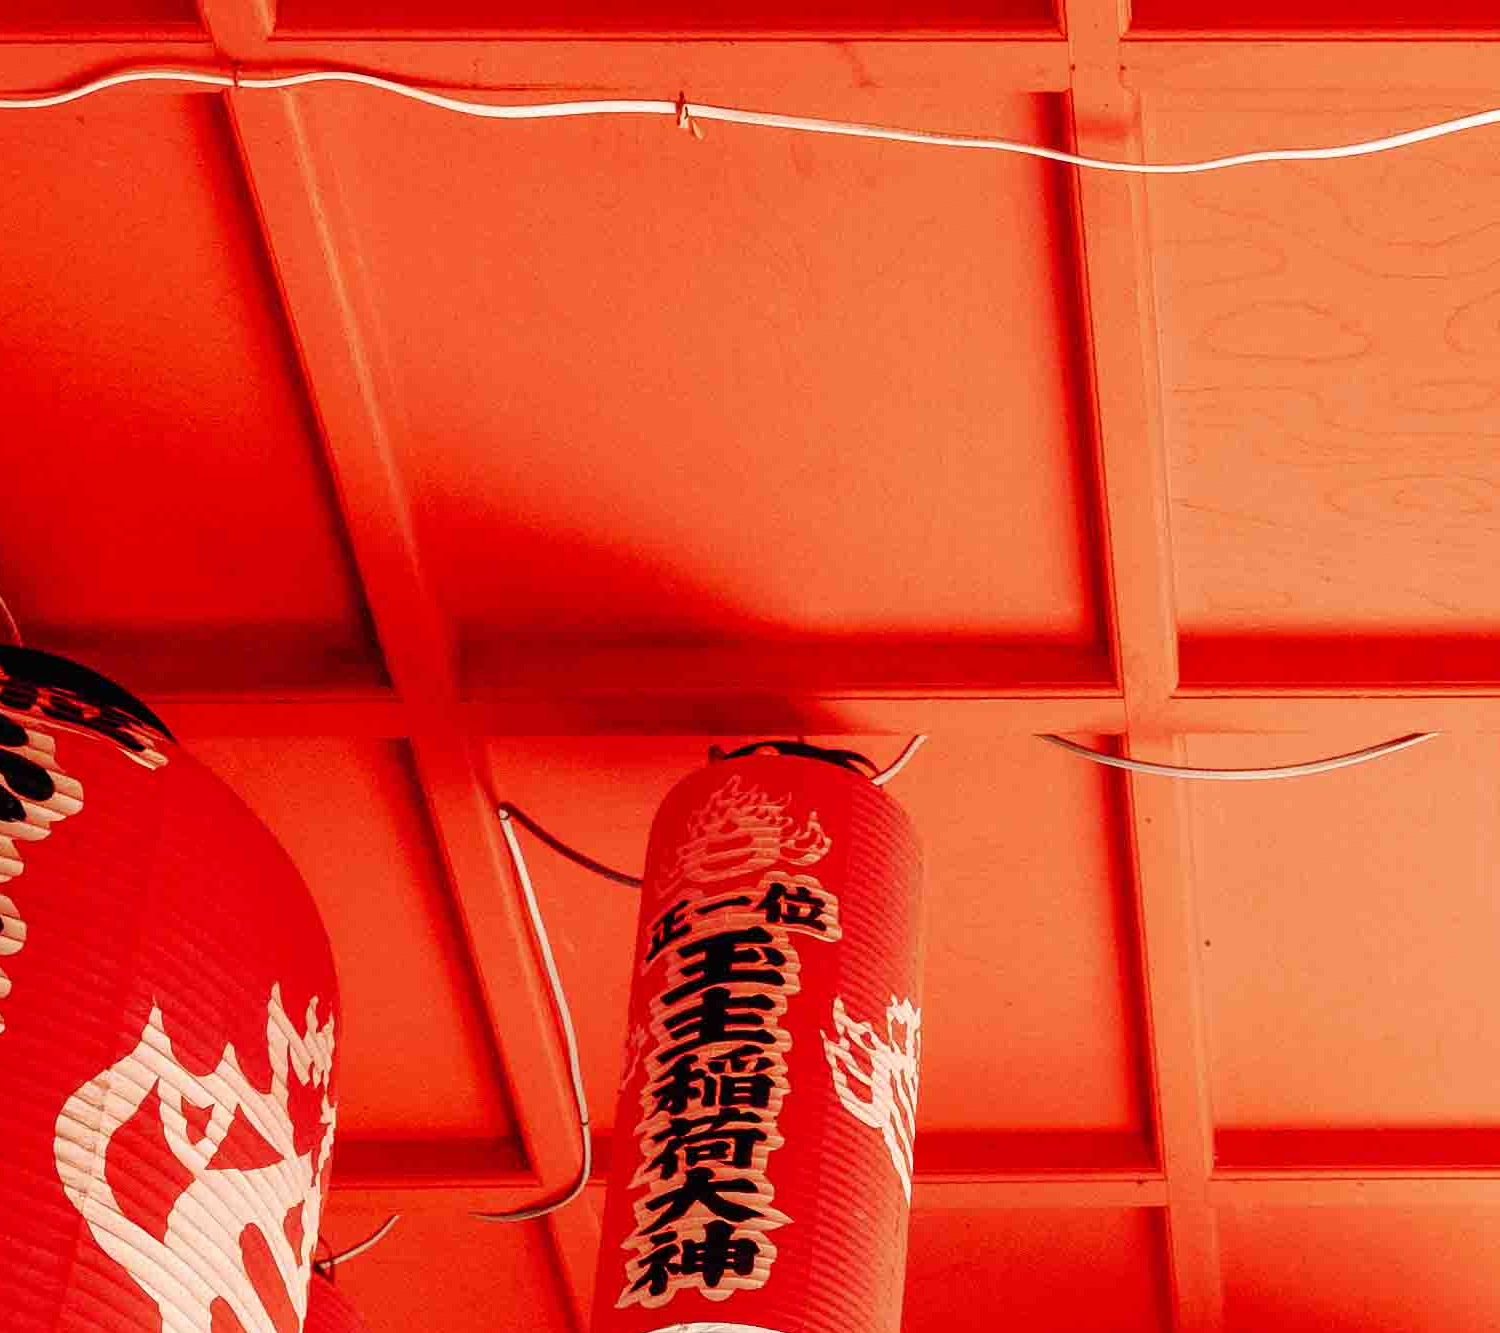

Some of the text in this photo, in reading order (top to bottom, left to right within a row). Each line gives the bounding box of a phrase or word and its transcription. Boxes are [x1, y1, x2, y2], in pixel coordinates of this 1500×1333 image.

[645, 880, 830, 962] 正一位
[632, 926, 790, 1297] 玉主稲荷大神
